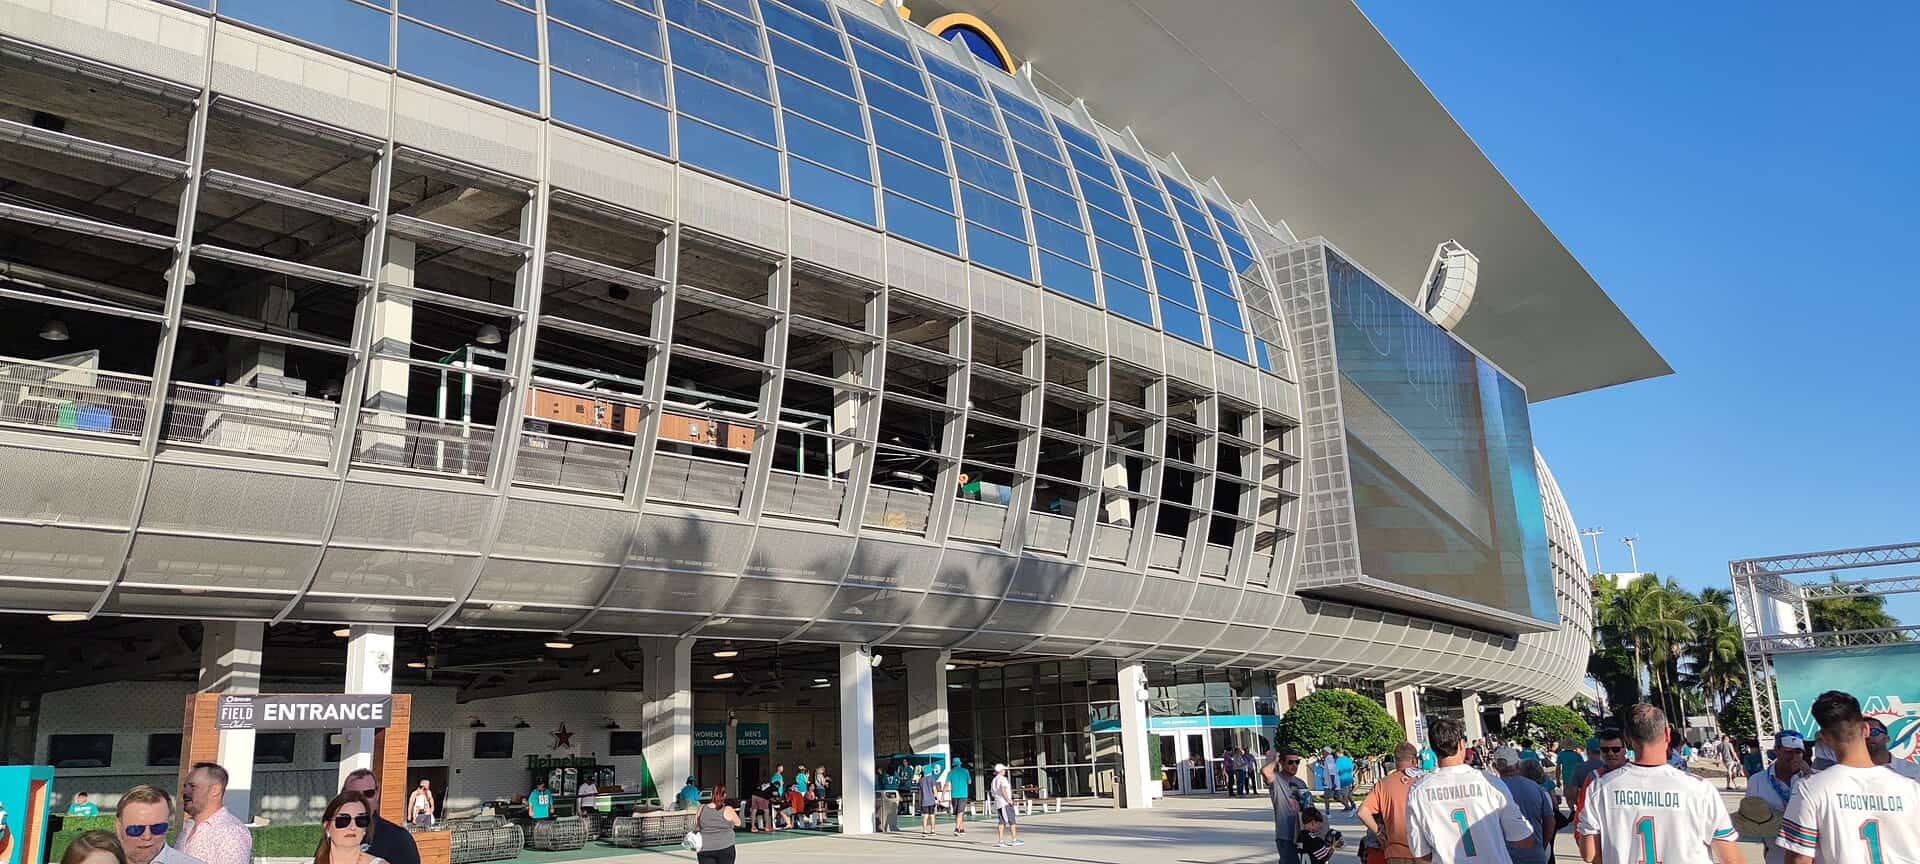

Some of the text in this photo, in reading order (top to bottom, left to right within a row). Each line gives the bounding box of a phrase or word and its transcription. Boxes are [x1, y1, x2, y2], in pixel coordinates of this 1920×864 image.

[221, 707, 253, 721] FIELD
[263, 703, 384, 721] ENTRANCE
[744, 730, 761, 738] MEN'S
[528, 754, 597, 769] Heineken
[1425, 784, 1483, 801] TAGOVAILOA
[1614, 790, 1680, 808] TAGOVAILOA
[1836, 793, 1904, 812] TAGOVAILOA
[1450, 807, 1477, 857] 1
[1634, 816, 1664, 864] 1
[1859, 818, 1885, 864] 1
